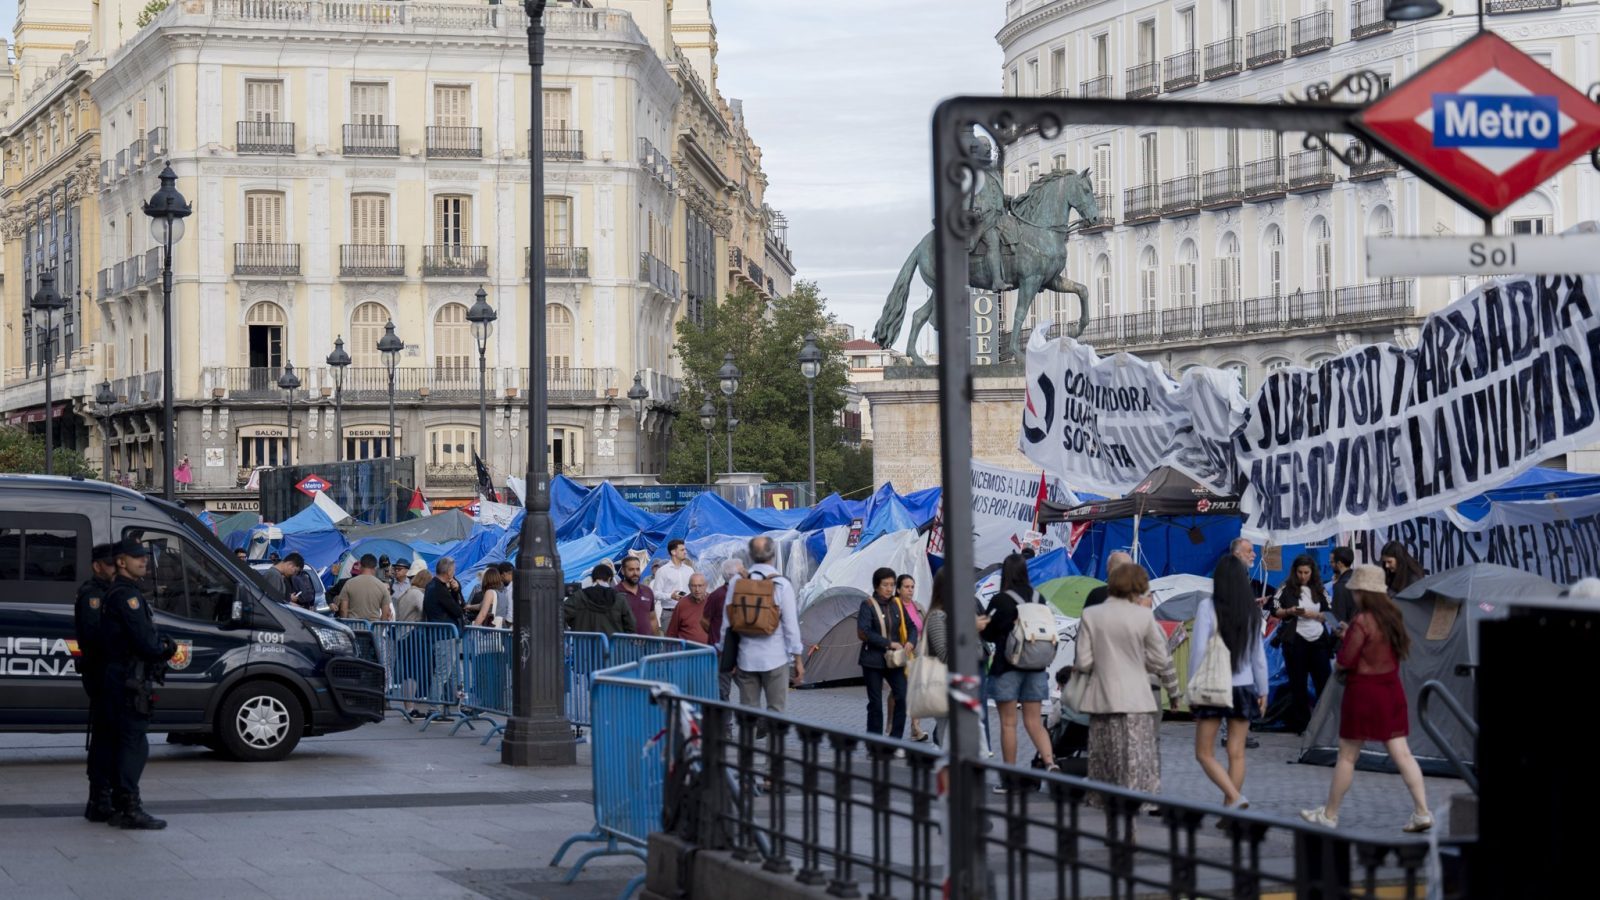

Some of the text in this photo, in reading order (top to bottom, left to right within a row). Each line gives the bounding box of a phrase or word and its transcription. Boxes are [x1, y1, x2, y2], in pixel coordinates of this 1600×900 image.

[1443, 100, 1552, 140] Metro
[1469, 242, 1516, 267] Sol
[1407, 405, 1455, 501] LA
[638, 491, 661, 499] CARDS
[1014, 477, 1026, 497] LA
[988, 496, 1008, 516] POR
